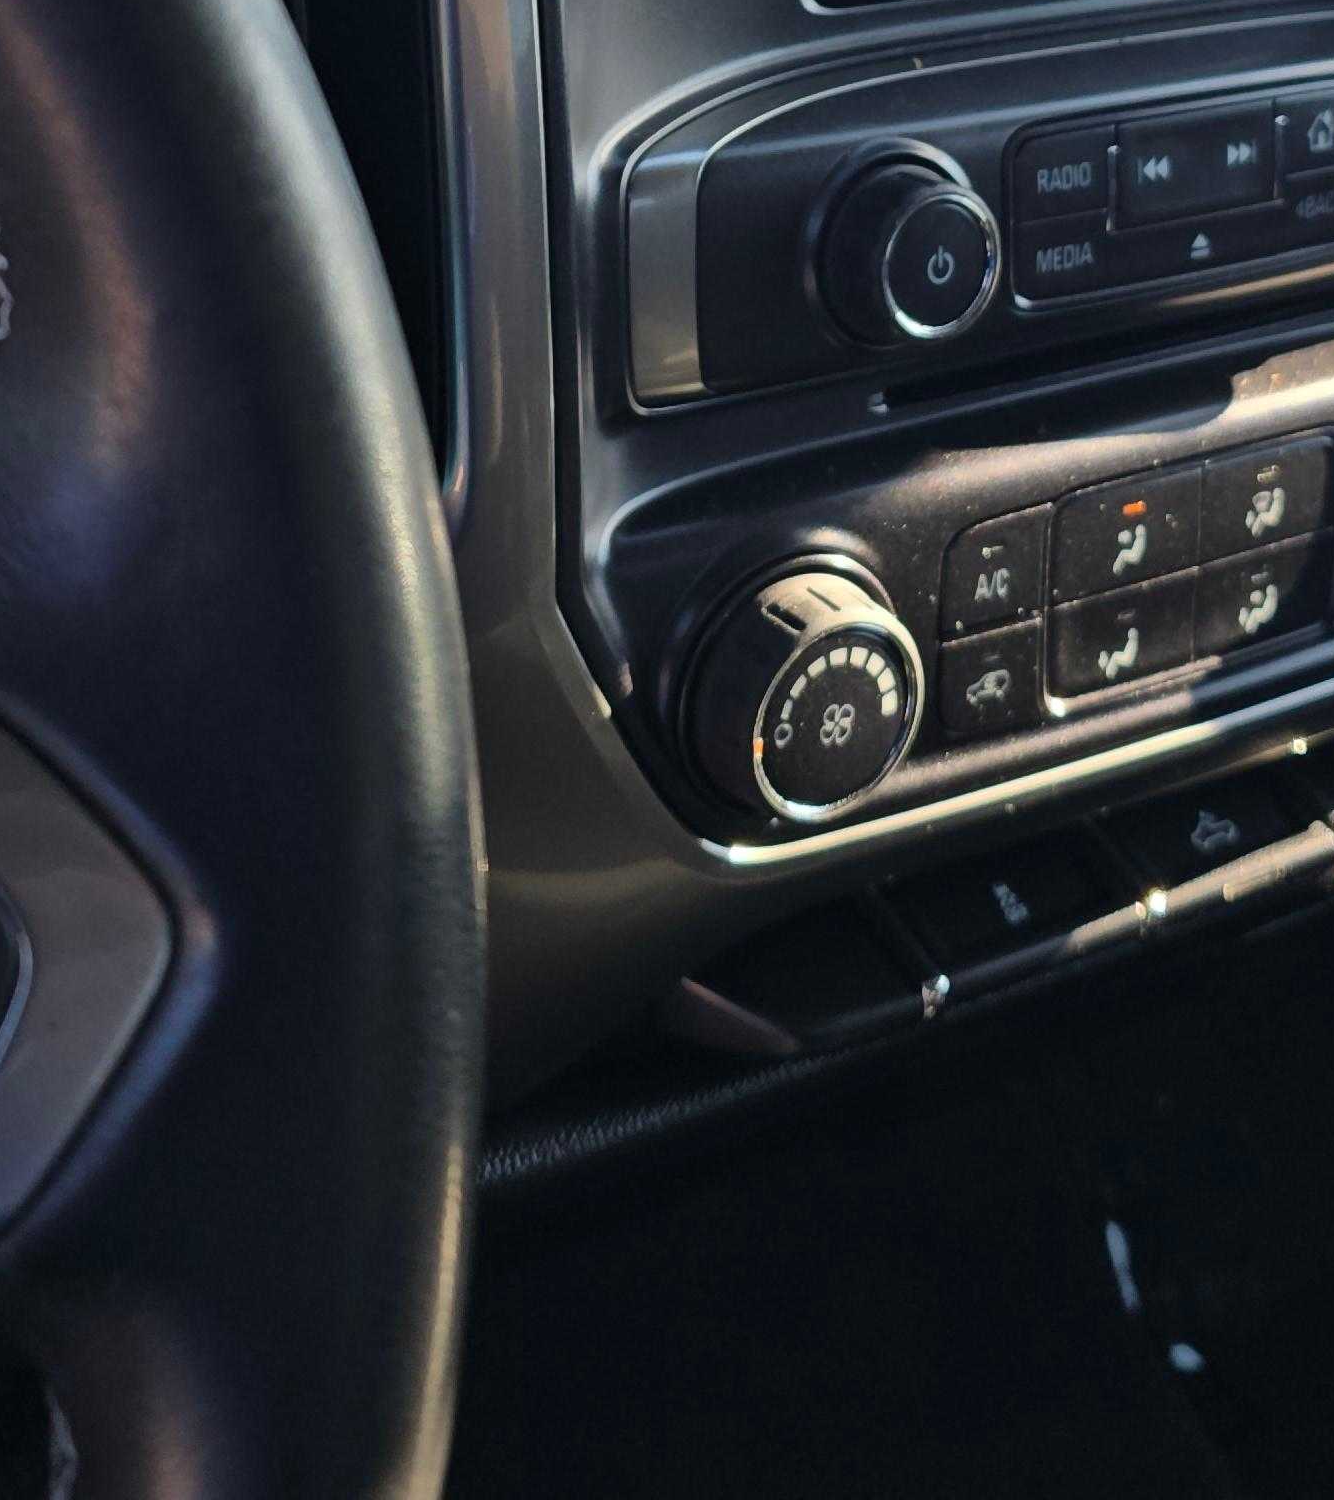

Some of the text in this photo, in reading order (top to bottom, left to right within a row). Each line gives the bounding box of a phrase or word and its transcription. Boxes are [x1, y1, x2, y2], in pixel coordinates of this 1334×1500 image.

[1037, 161, 1092, 194] RADIO
[1036, 241, 1095, 275] MEDIA
[974, 567, 1011, 603] A/C
